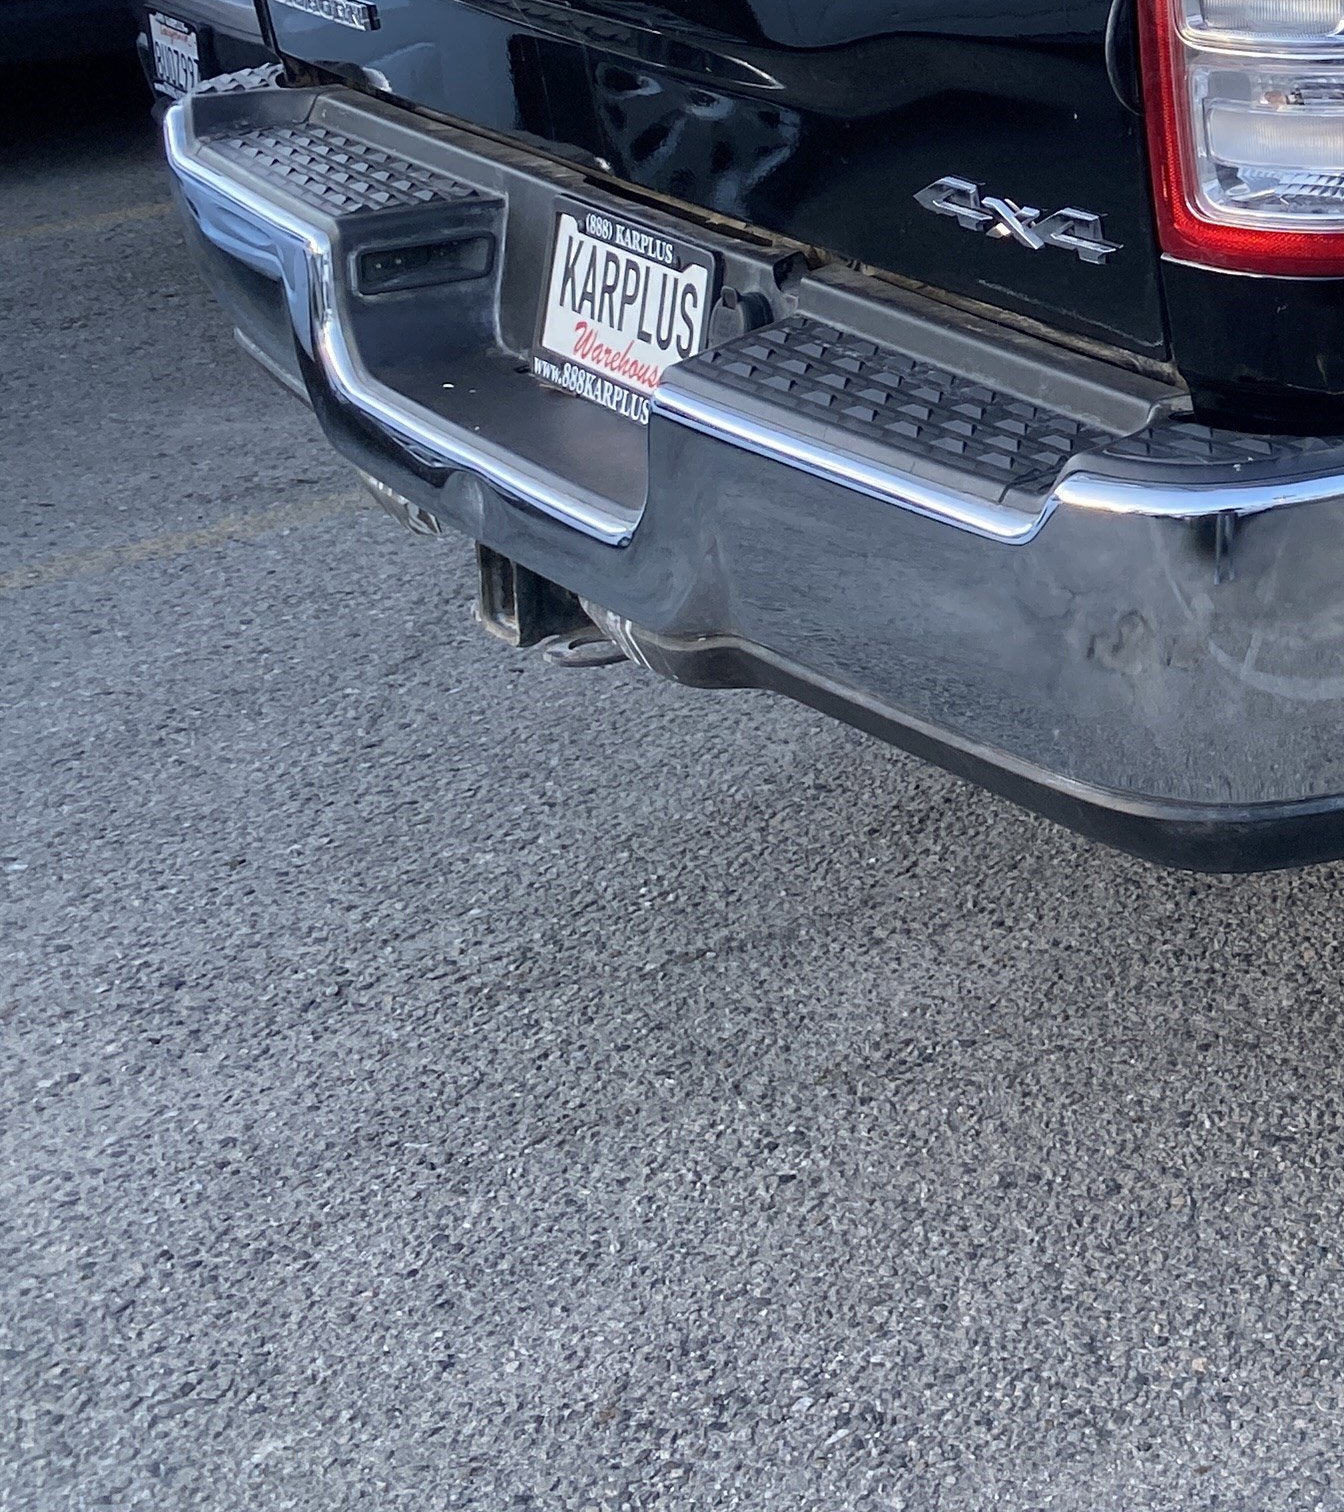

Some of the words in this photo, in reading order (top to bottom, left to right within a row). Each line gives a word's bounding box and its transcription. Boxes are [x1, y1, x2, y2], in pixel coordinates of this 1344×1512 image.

[585, 213, 613, 238] (888)
[616, 223, 674, 264] KARPLUS
[559, 235, 698, 359] KARPLUS
[573, 320, 661, 388] Warehous
